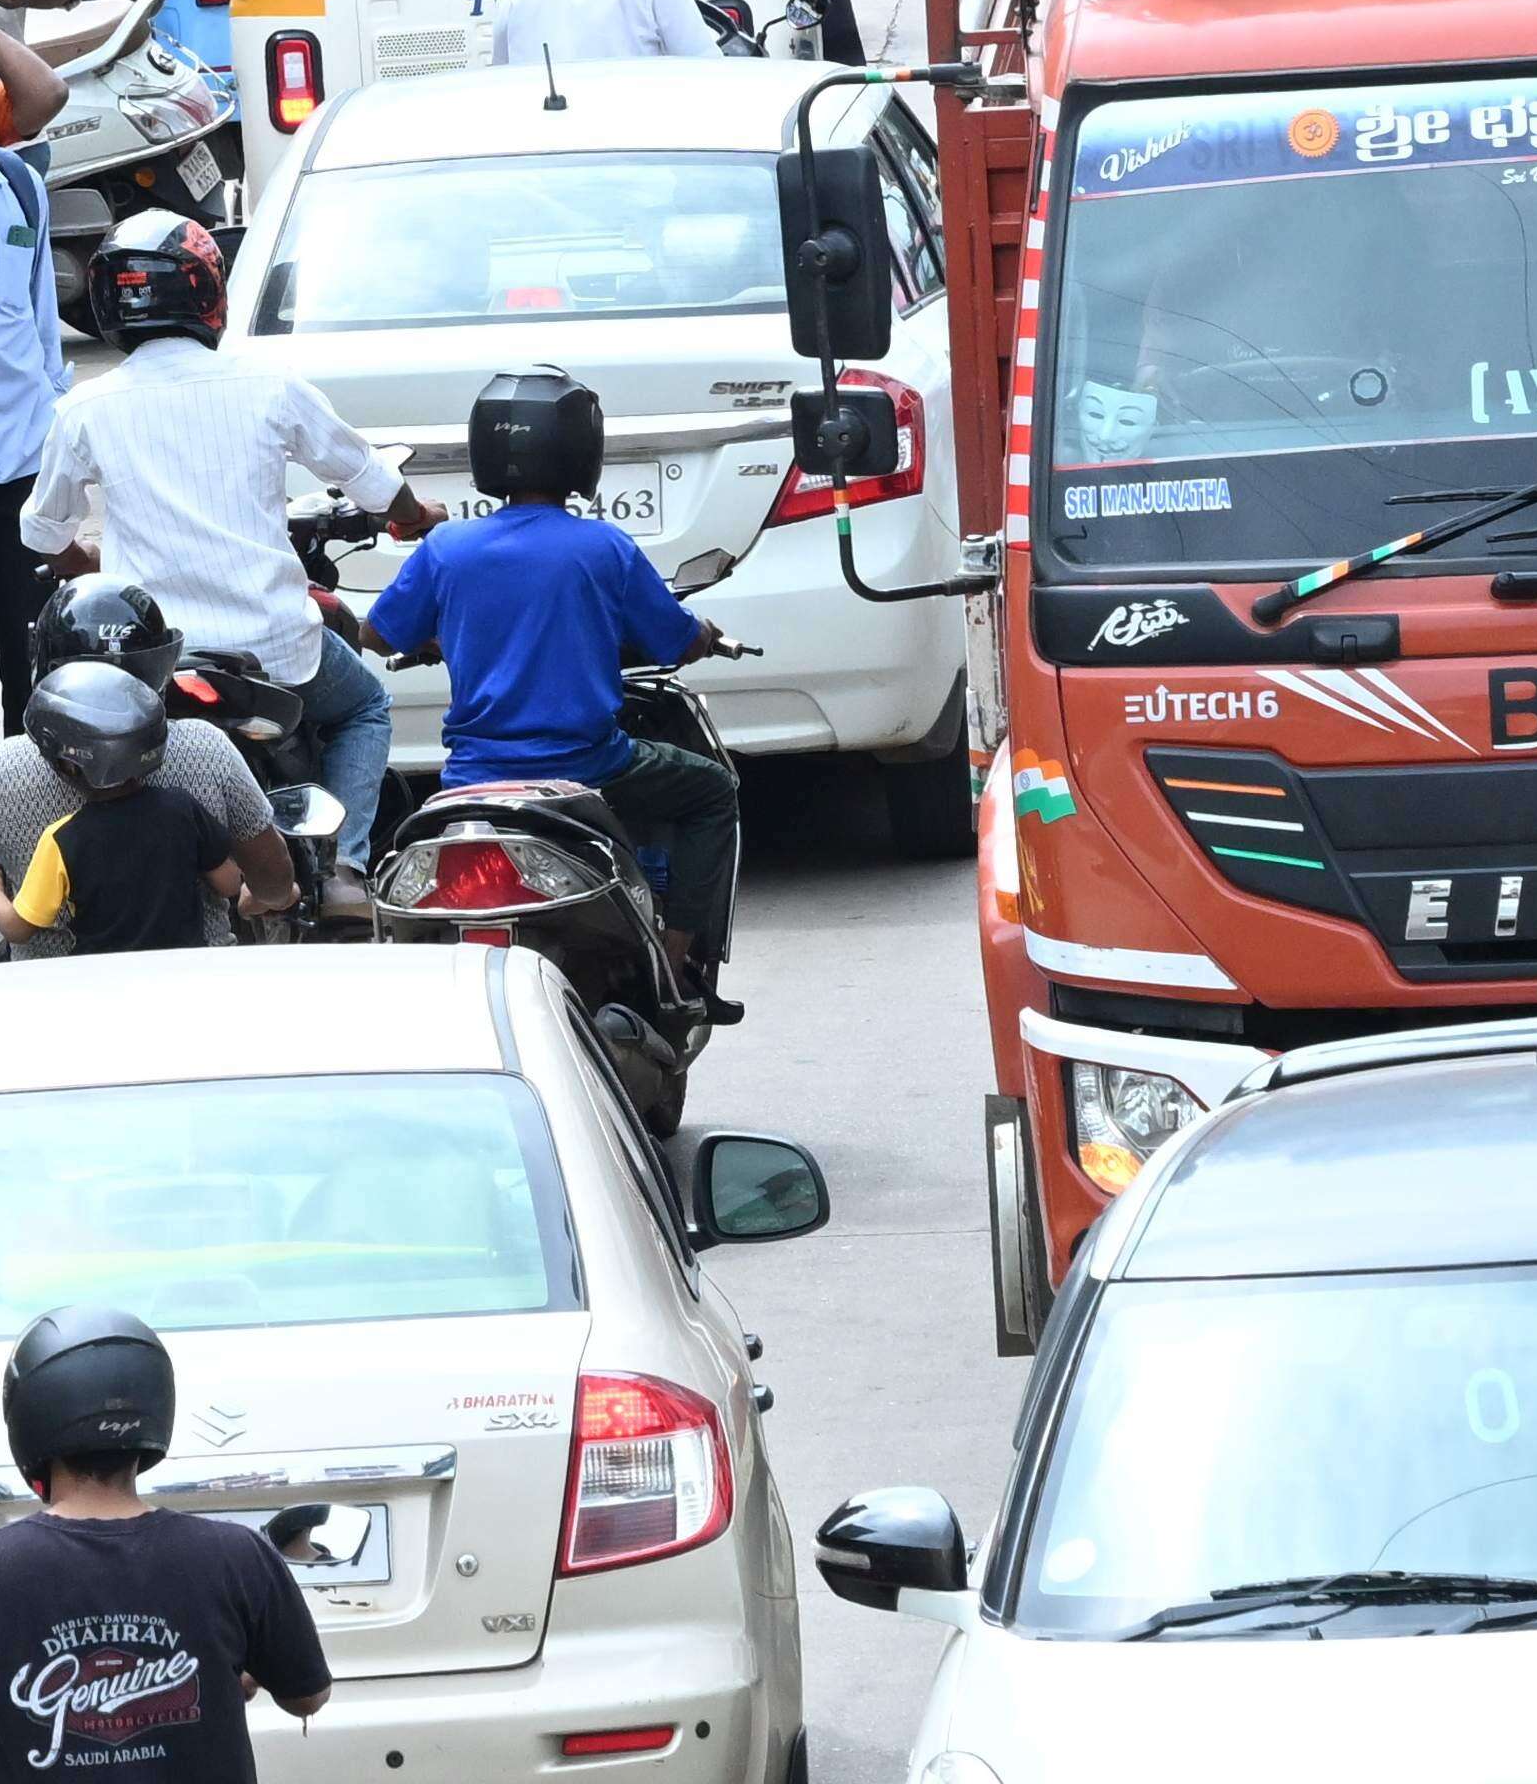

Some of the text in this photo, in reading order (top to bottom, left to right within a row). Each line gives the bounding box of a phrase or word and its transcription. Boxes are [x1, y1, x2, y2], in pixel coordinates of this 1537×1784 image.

[1355, 100, 1451, 163] ಶ್ರೀ
[1099, 119, 1195, 183] Vishak
[1502, 168, 1528, 186] Sri
[709, 380, 793, 395] SWIFT
[1063, 476, 1232, 520] SRI MANJUNATHA
[463, 1393, 537, 1410] BHARATH
[484, 1413, 560, 1432] SX4
[41, 1623, 181, 1658] DHAHRAN
[9, 1650, 200, 1769] Genuine
[64, 1744, 167, 1768] SAUDI ARABIA
